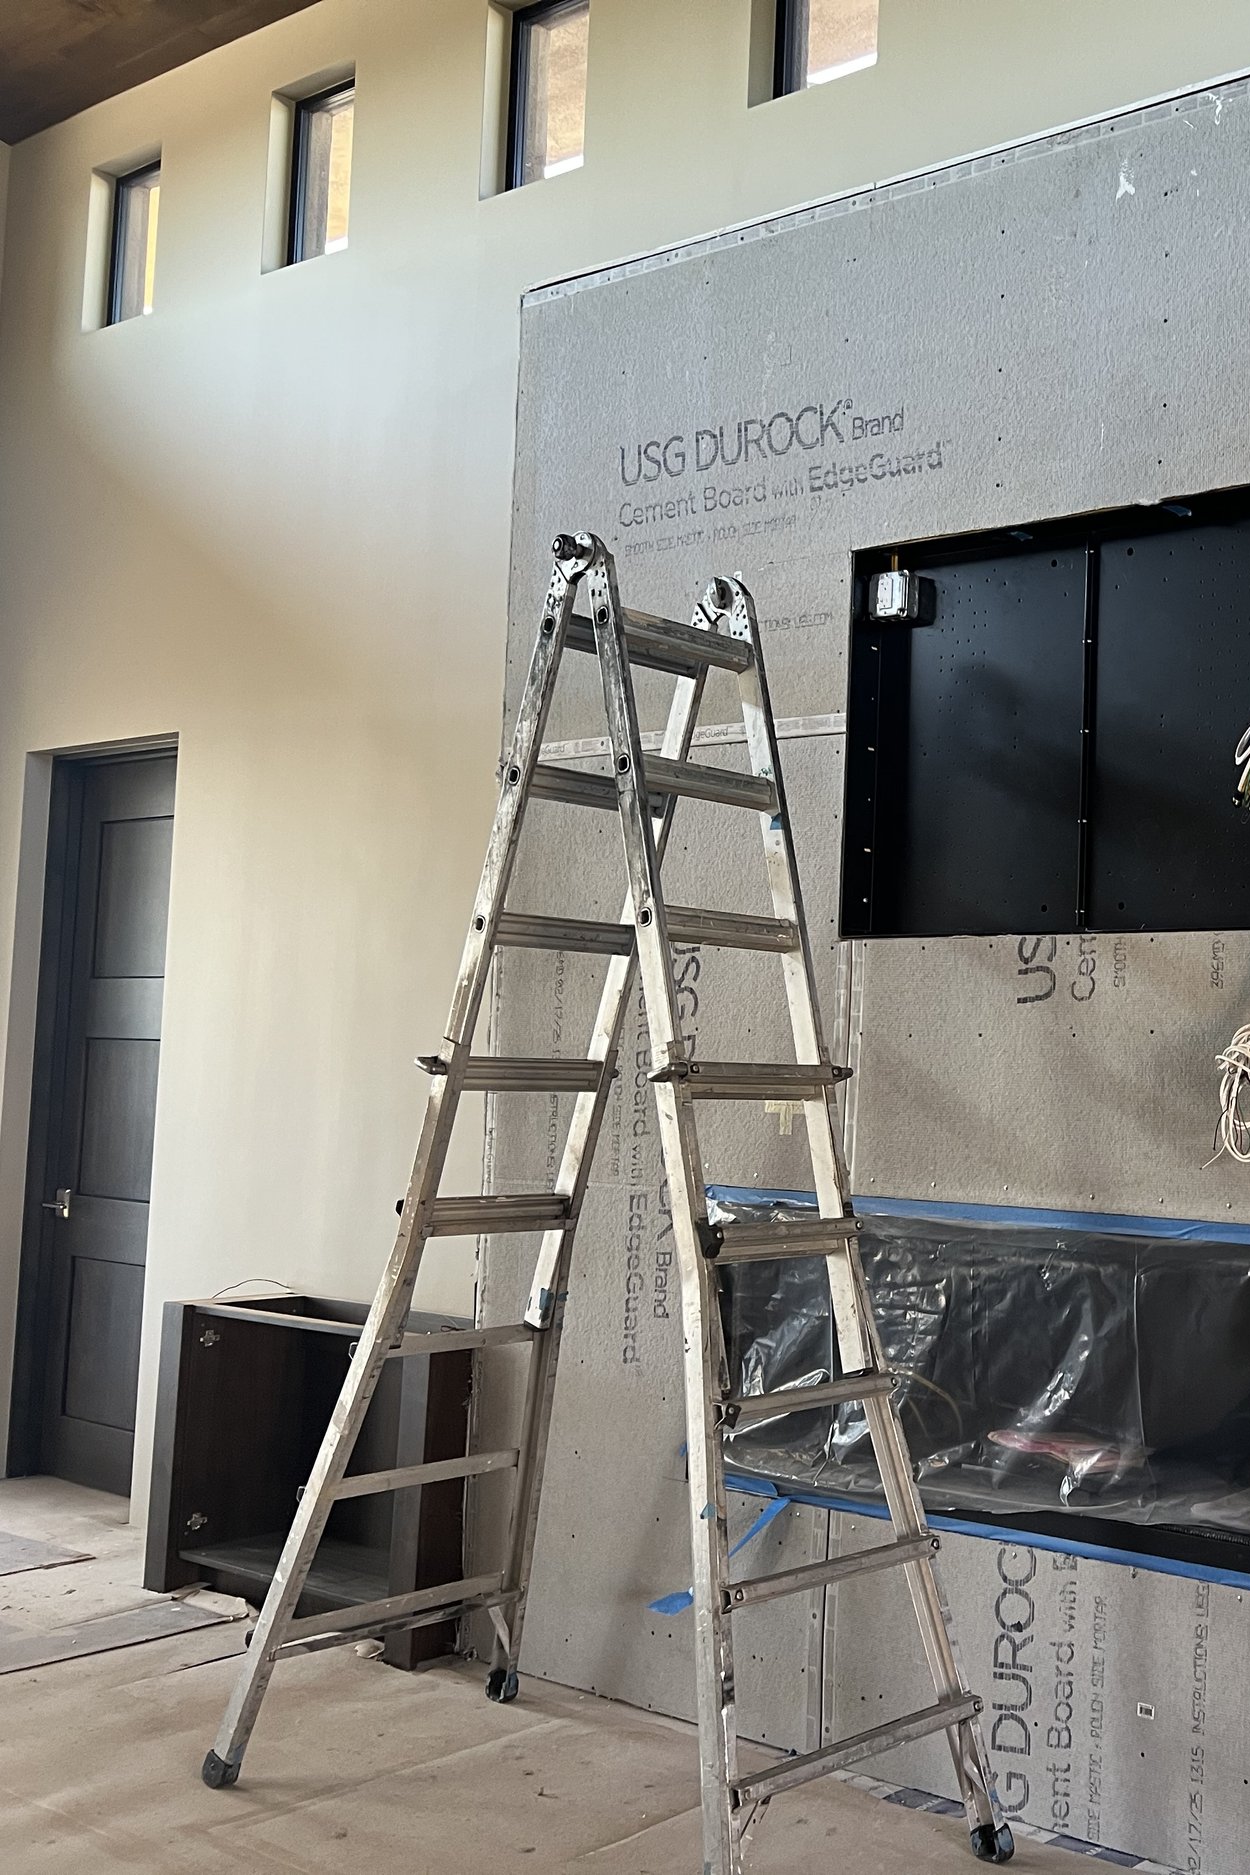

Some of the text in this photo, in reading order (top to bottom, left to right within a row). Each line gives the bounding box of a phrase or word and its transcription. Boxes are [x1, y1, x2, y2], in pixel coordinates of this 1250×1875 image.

[618, 434, 686, 487] USG
[851, 407, 905, 441] Brand
[618, 493, 697, 528] Cement
[702, 478, 767, 513] Board
[770, 477, 805, 500] with
[632, 1051, 653, 1139] Board
[622, 1194, 650, 1364] EdgeGuard
[653, 1251, 673, 1319] Brand
[991, 1541, 1037, 1756] DUROC
[1058, 1580, 1078, 1634] with
[1046, 1641, 1075, 1749] Board
